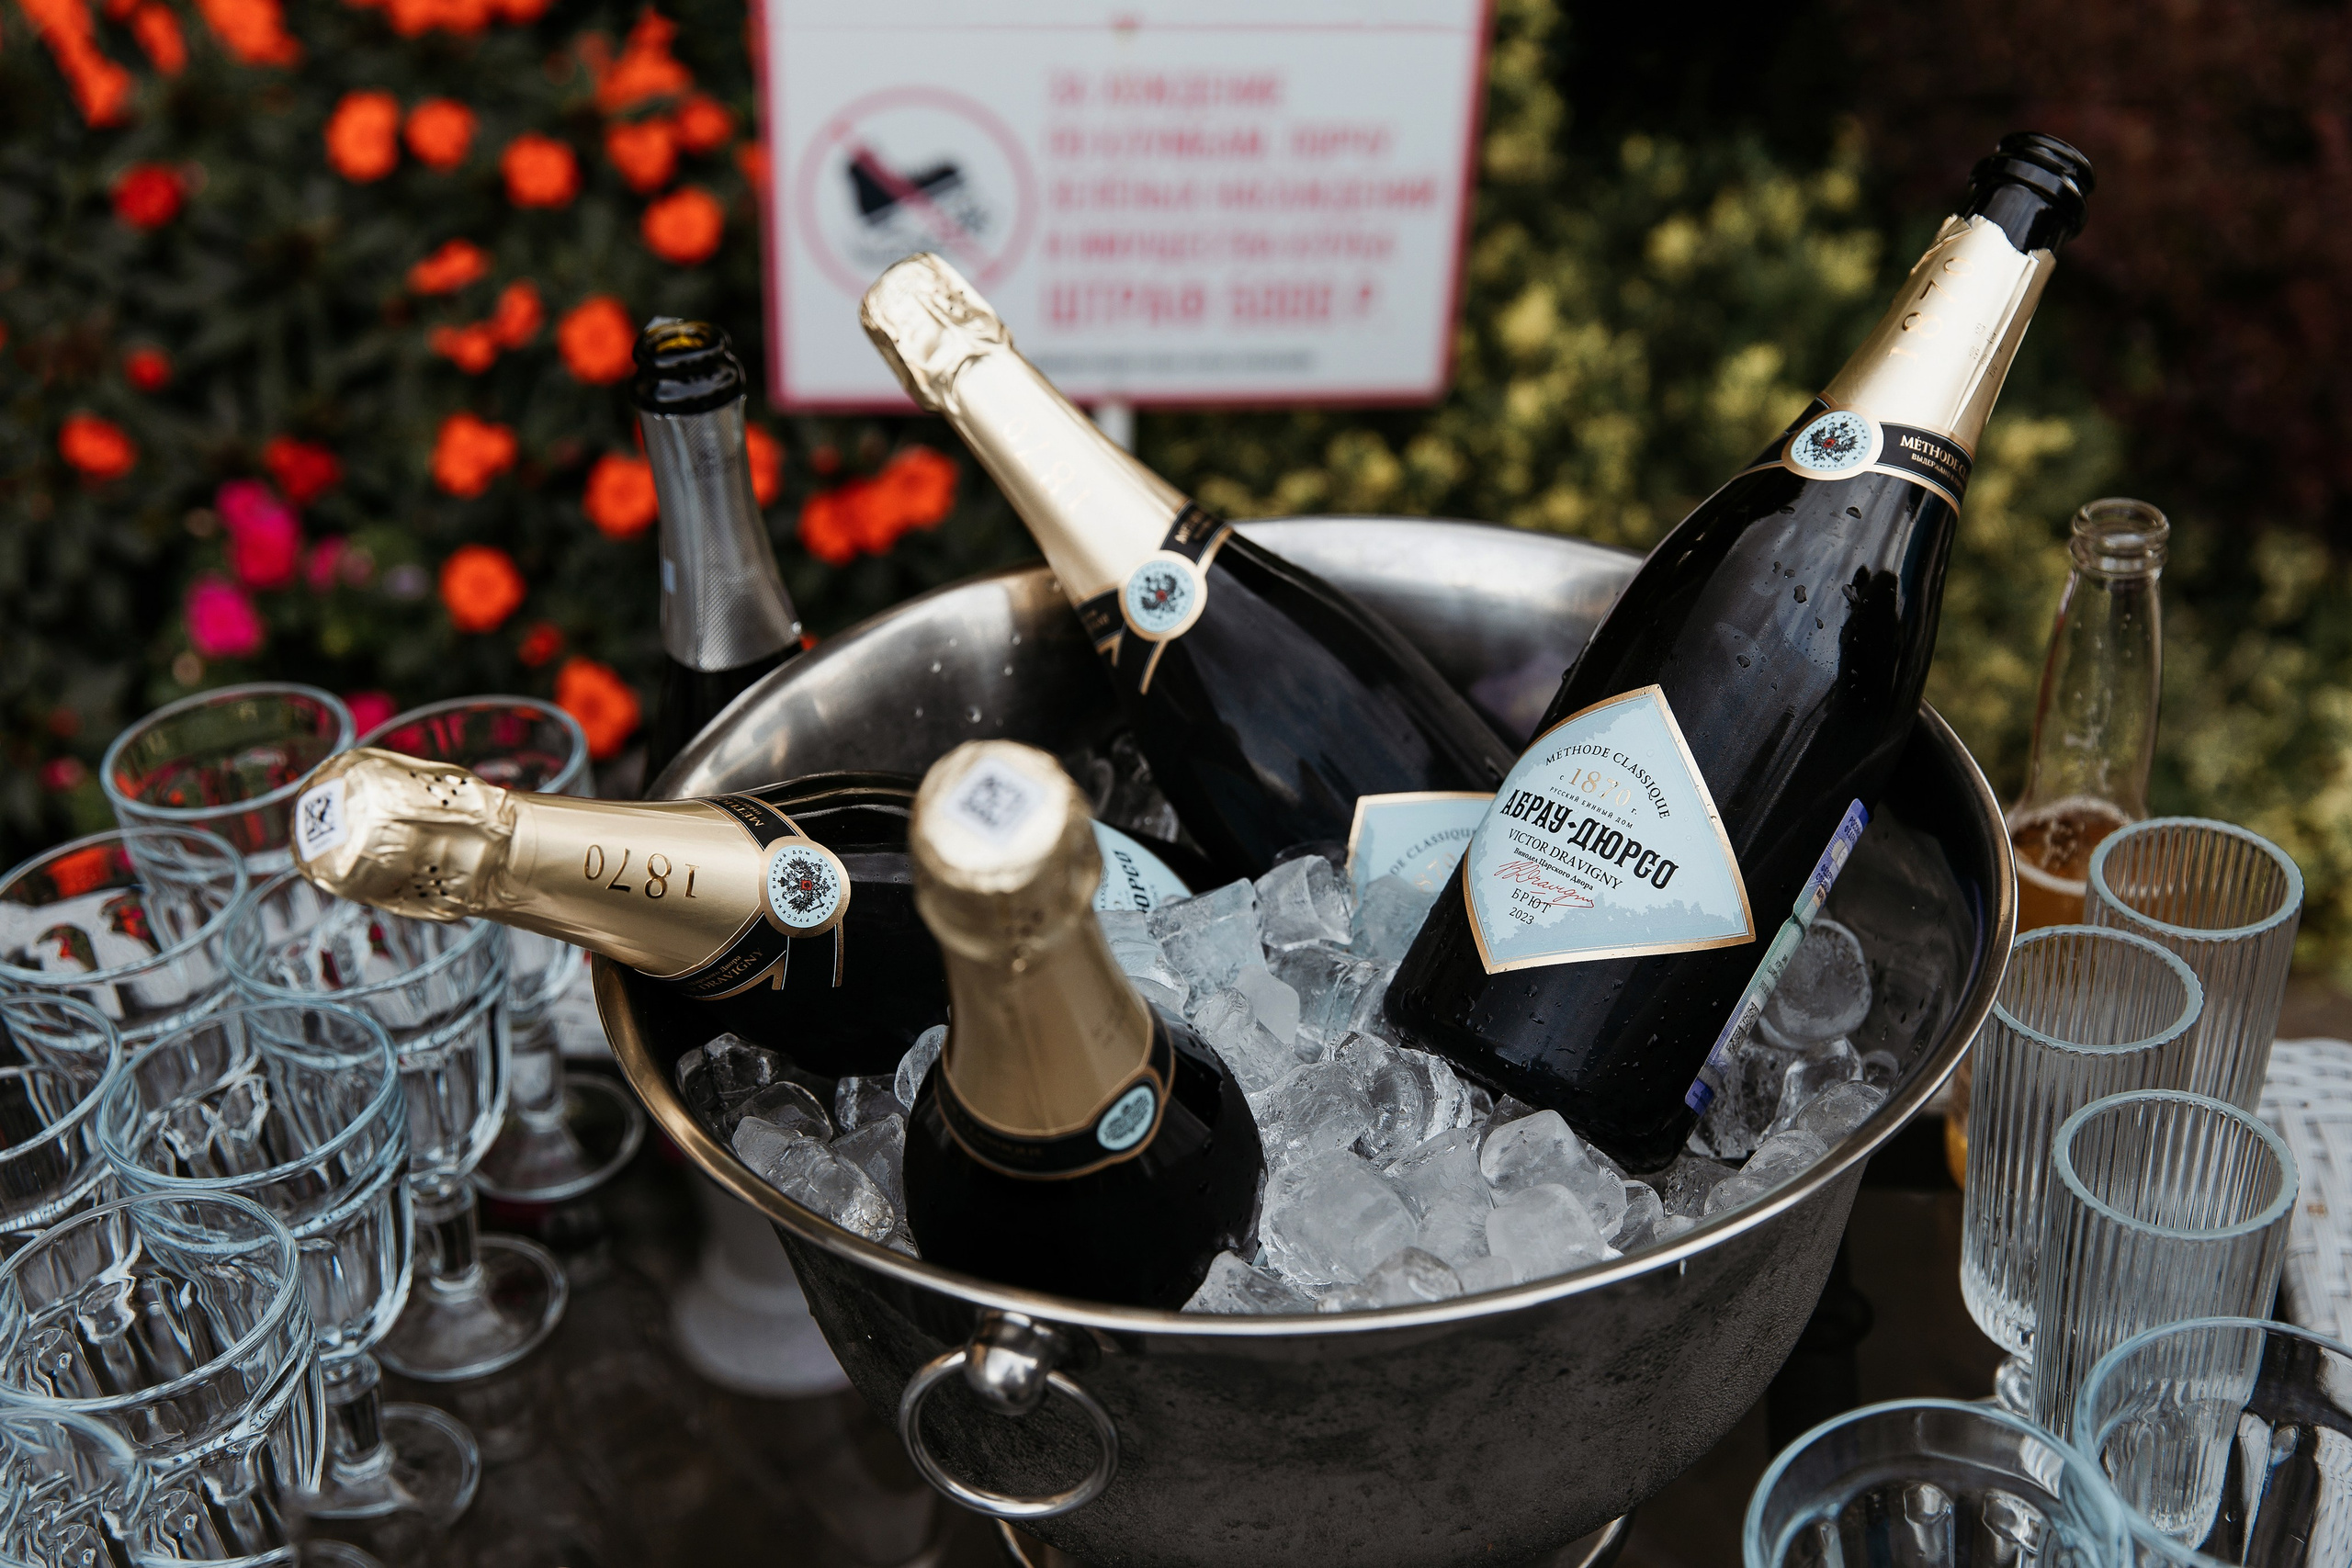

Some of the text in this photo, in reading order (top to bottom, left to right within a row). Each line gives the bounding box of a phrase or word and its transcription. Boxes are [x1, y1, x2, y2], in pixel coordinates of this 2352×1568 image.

[1545, 744, 1670, 819] MÉTHODE CLASSIQUE
[1568, 767, 1632, 807] 1870
[1549, 786, 1634, 829] РУССКИЙ ВИННЫЙ ДОМ
[582, 843, 700, 899] 1870
[791, 849, 810, 857] ДОМ
[1414, 852, 1457, 895] 870
[1509, 829, 1623, 890] VICTOR DRAVIGNY
[1513, 847, 1594, 891] Винодел Царского Двора
[1509, 907, 1535, 925] 2023
[1511, 888, 1552, 914] БРЮТ
[698, 947, 763, 990] DRAVIGNY
